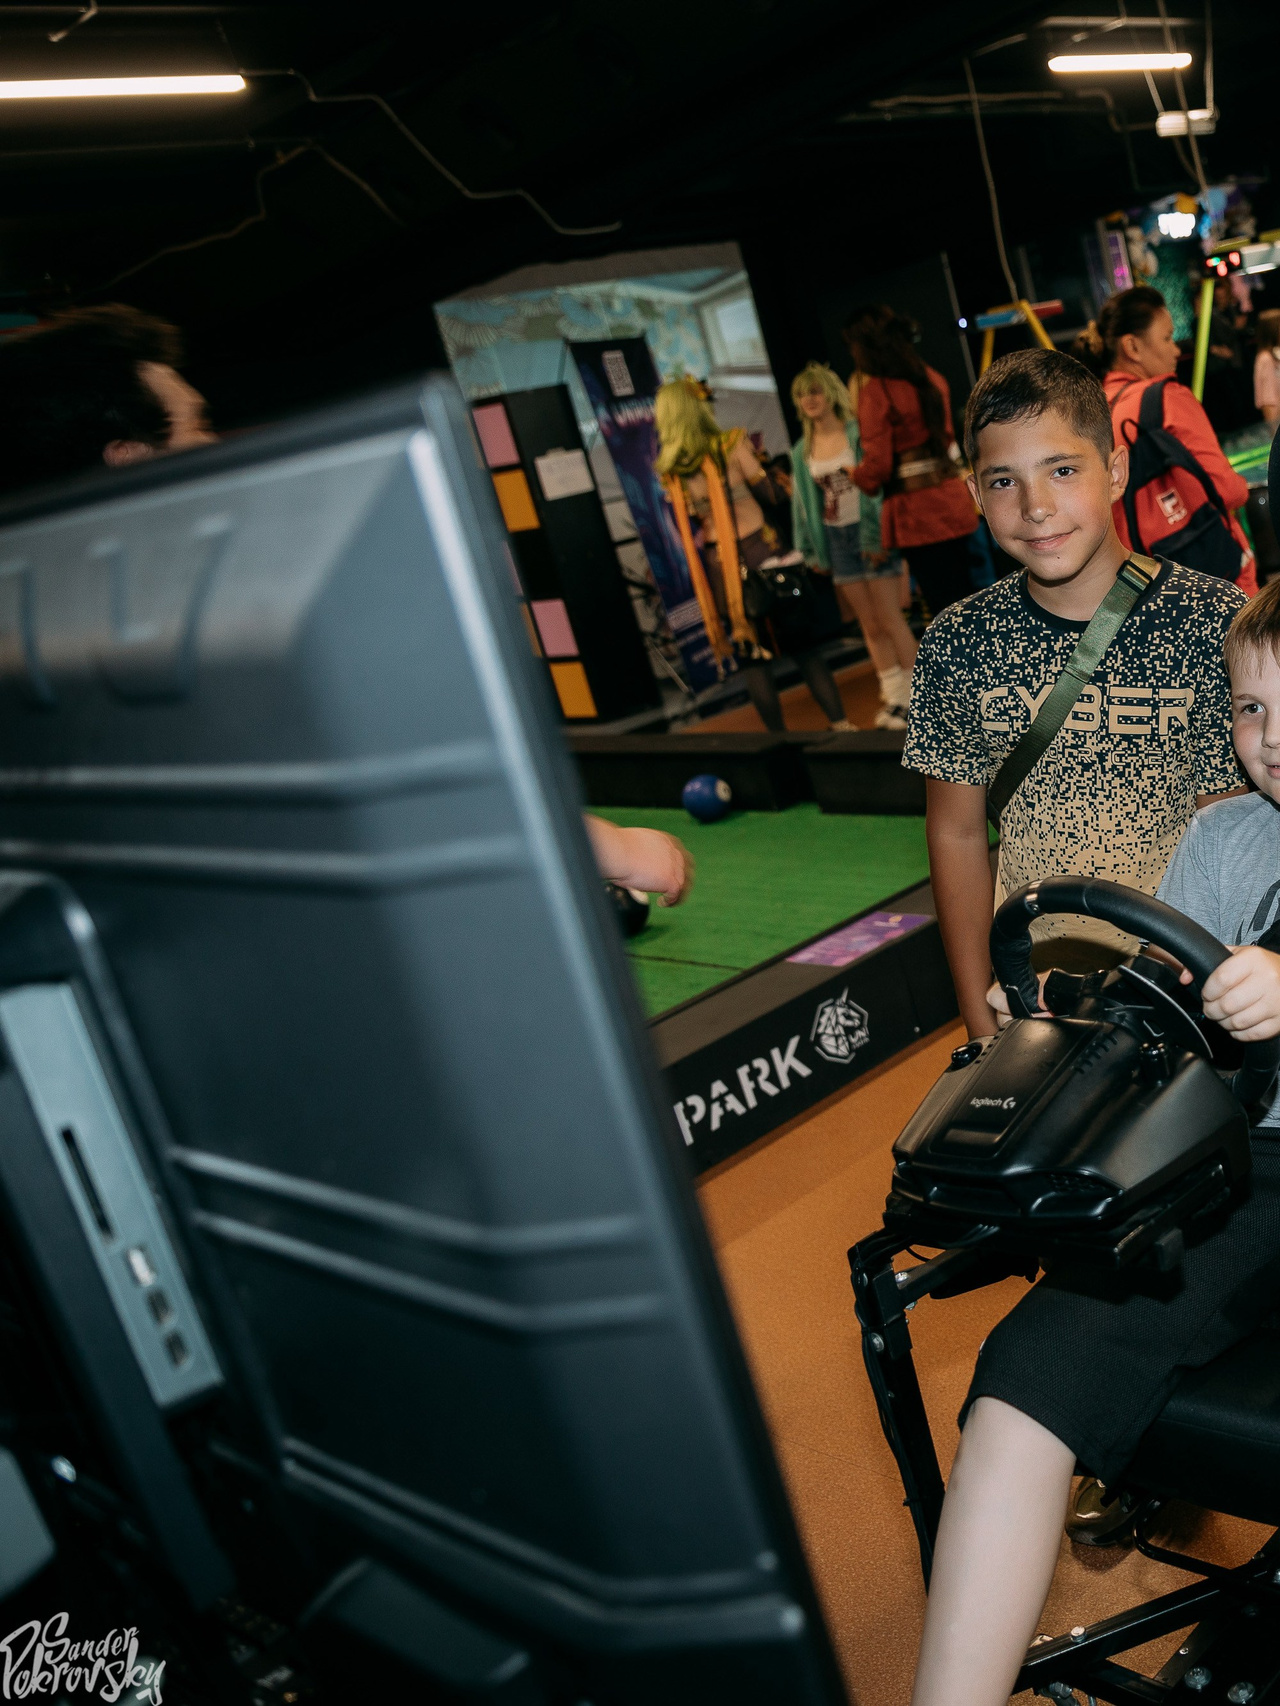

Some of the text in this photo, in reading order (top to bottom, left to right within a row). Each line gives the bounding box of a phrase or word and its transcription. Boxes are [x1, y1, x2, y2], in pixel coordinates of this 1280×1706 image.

[980, 683, 1196, 736] CYBER
[1048, 744, 1164, 766] ORCE
[672, 1034, 813, 1148] PARK
